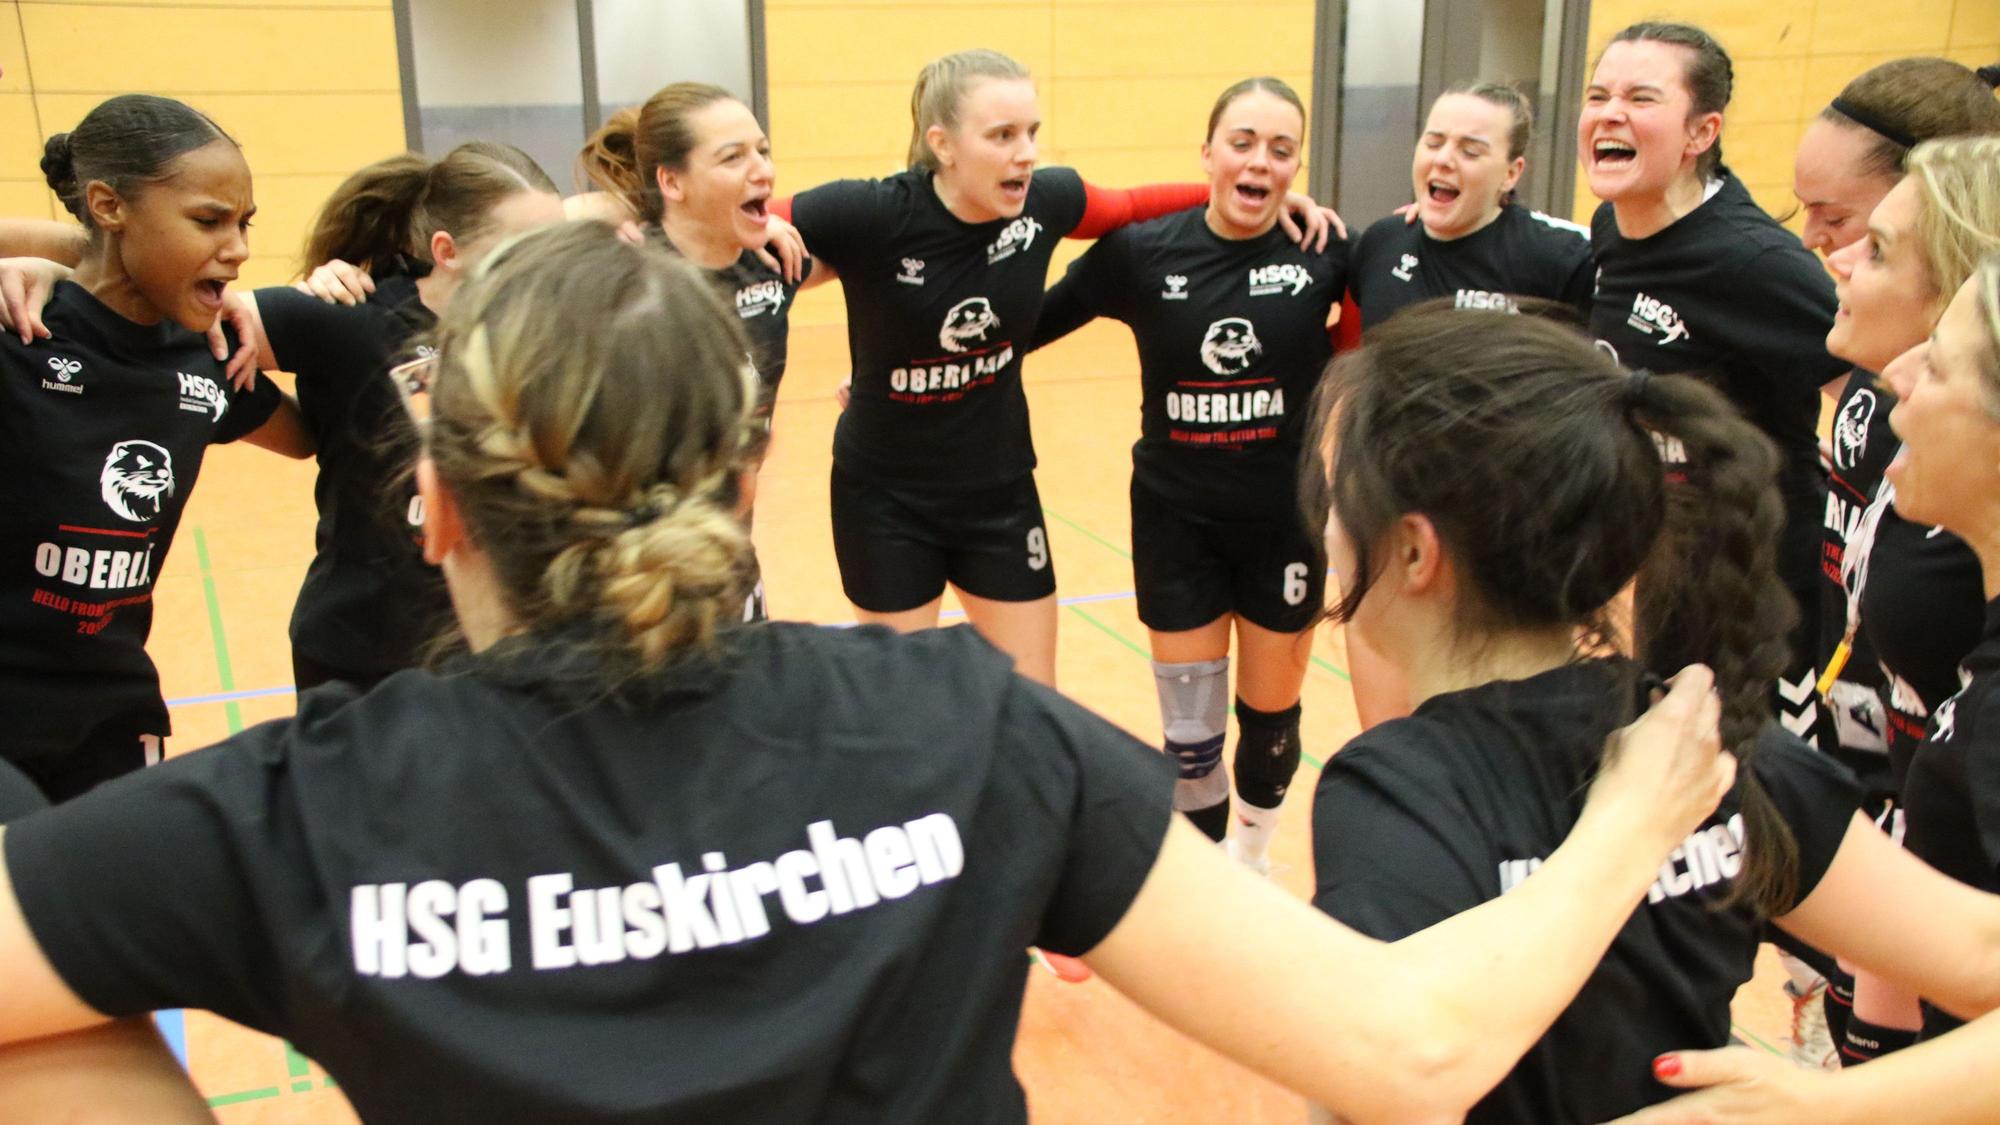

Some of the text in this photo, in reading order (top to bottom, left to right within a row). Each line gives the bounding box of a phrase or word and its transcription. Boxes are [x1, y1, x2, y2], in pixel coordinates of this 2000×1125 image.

[1250, 264, 1297, 286] HSG
[736, 280, 776, 308] HSG
[1455, 289, 1506, 310] HSG
[1633, 292, 1673, 328] HSG
[42, 378, 84, 395] hummel
[177, 371, 218, 402] HSG
[1166, 388, 1284, 423] OBERLIGA
[1026, 526, 1049, 571] 9
[1283, 562, 1308, 606] 6
[32, 589, 70, 612] HELLO
[351, 812, 965, 978] HSG Euskirchen
